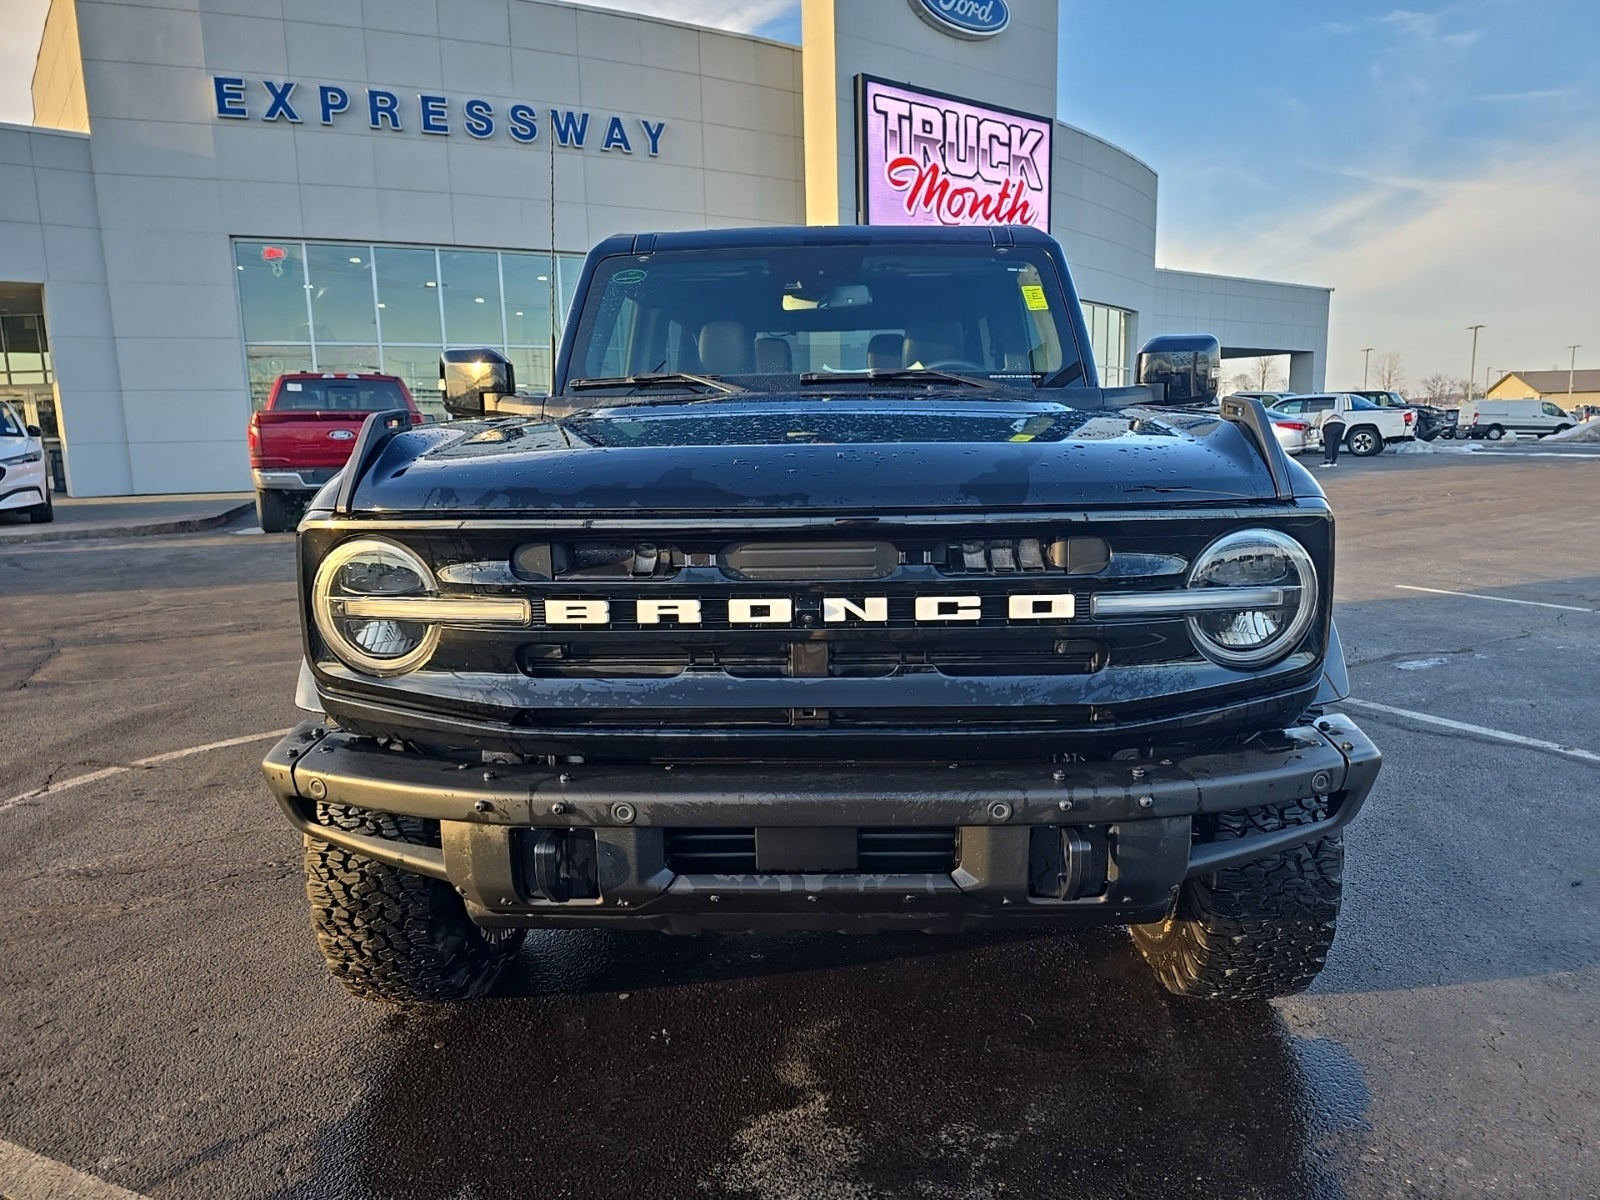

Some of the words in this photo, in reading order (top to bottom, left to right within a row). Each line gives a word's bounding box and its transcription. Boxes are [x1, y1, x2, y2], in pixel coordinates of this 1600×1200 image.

[212, 75, 667, 157] EXPRESSWAY
[873, 93, 1044, 191] TRUCK
[886, 156, 1035, 226] Month
[544, 593, 1076, 625] BRONCO
